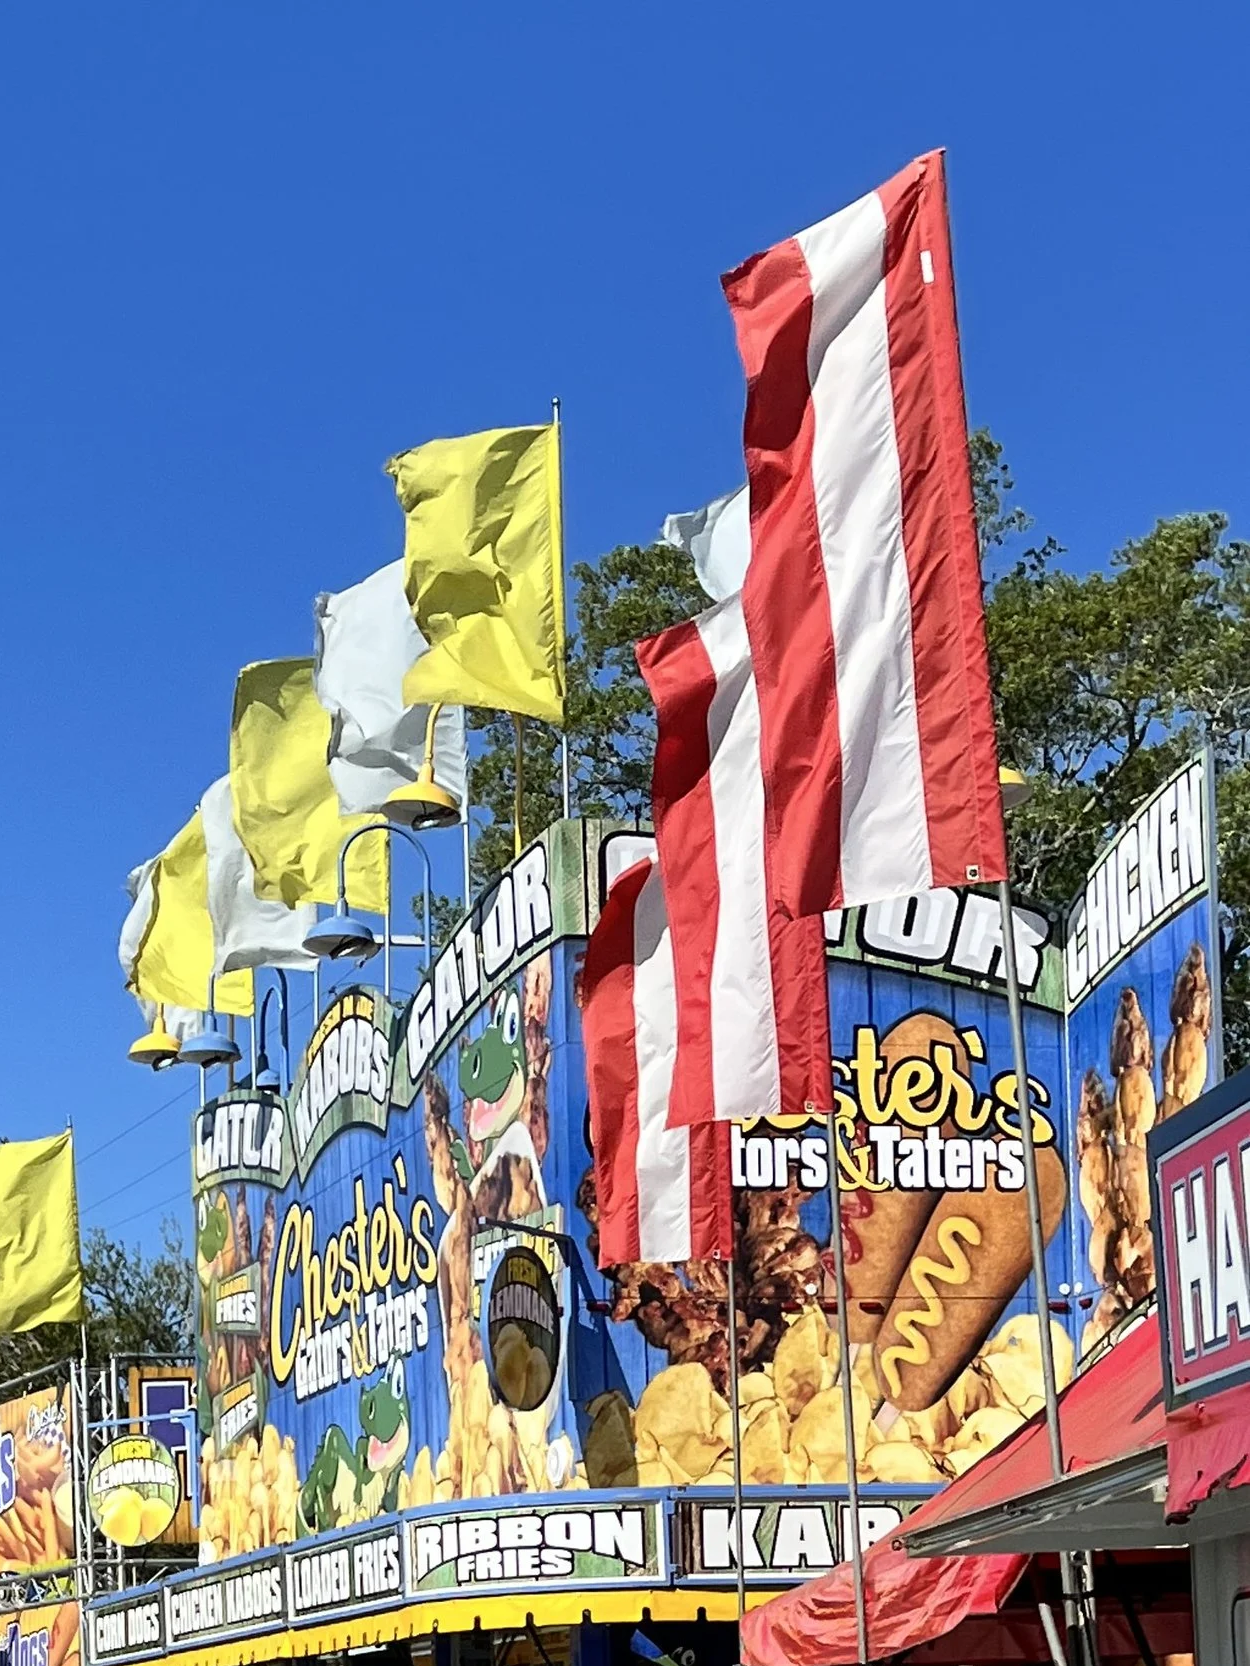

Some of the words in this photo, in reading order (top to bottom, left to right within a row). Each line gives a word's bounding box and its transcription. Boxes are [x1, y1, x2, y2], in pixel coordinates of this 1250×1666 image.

[1066, 761, 1205, 1003] CHICKEN
[406, 841, 553, 1084] GATOR
[295, 1017, 390, 1160] KABOBS
[196, 1101, 285, 1181] GATOR
[731, 1124, 830, 1189] tors
[868, 1124, 1027, 1189] Taters
[271, 1155, 439, 1382] Chester's
[1172, 1140, 1250, 1360] HA
[216, 1291, 256, 1325] FRIES
[295, 1318, 353, 1401] Gators
[364, 1283, 429, 1366] Taters
[491, 1284, 555, 1335] LEMONADE
[220, 1395, 258, 1450] FRIES
[92, 1458, 176, 1497] LEMONADE
[294, 1548, 350, 1610] LOADED
[353, 1535, 399, 1598] FRIES
[415, 1509, 646, 1583] RIBBON
[458, 1548, 575, 1583] FRIES
[96, 1611, 126, 1651] CORN
[128, 1602, 160, 1646] DOGS
[170, 1580, 223, 1636] CHICKEN
[225, 1566, 281, 1623] KABOBS
